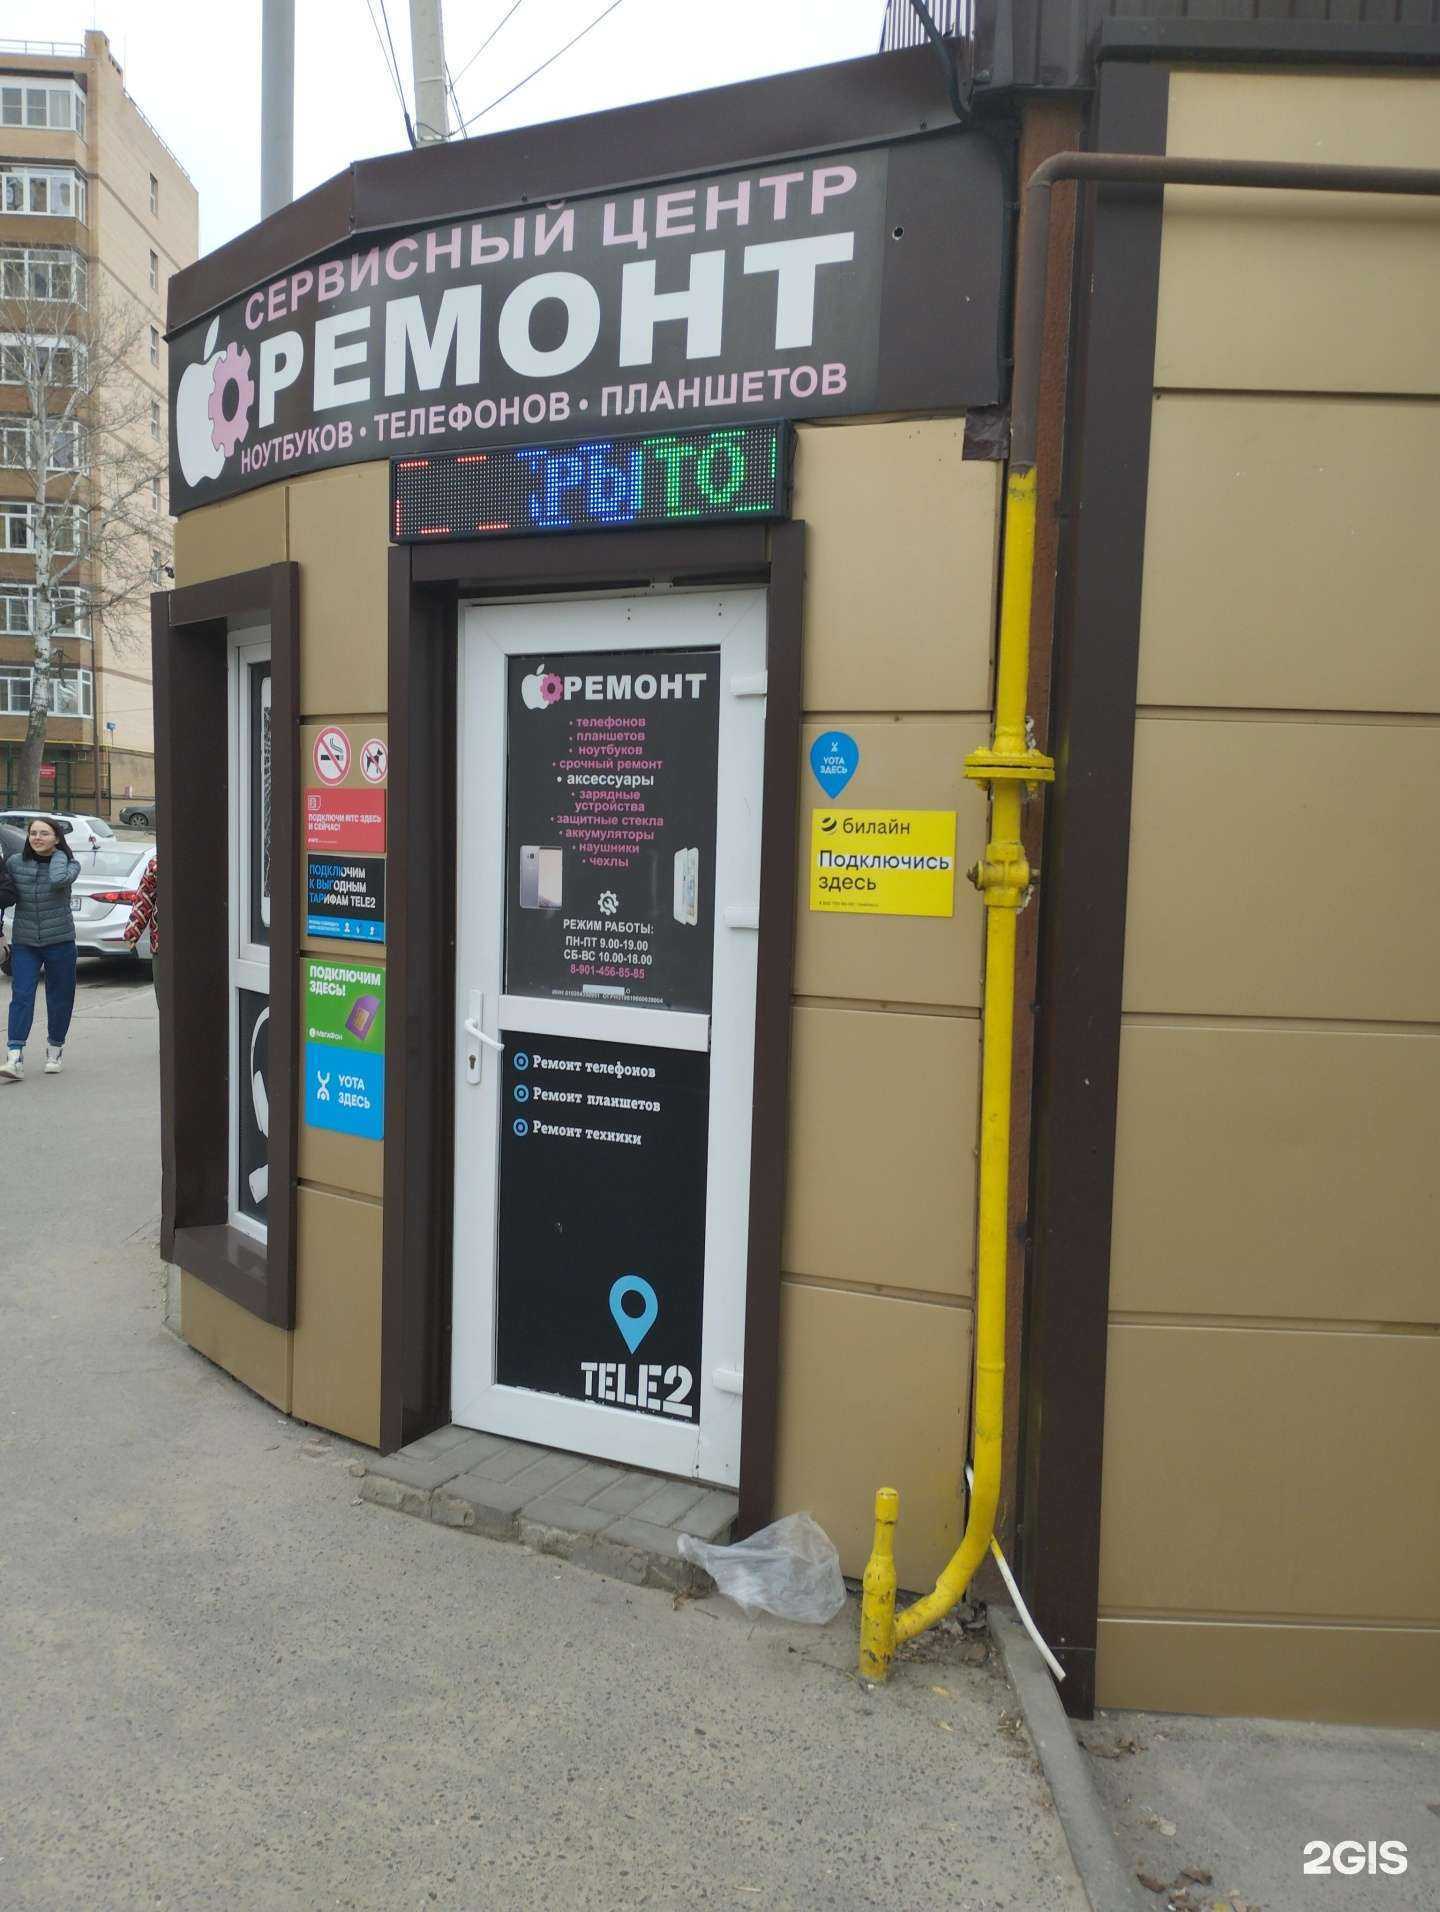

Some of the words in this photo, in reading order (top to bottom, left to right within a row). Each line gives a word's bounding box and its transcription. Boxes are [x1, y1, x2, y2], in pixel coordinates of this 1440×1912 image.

[245, 202, 575, 330] СЕРВИСНЫЙ
[602, 165, 858, 248] ЦЕНТР
[257, 232, 854, 428] РЕМОНТ
[241, 422, 353, 474] НОУТБУКОВ
[374, 391, 570, 441] ТЕЛЕФОНОВ
[601, 363, 847, 417] ПЛАНШЕТОВ
[564, 673, 707, 700] РЕМОНТ
[576, 716, 646, 730] телефонов
[577, 731, 645, 741] планшетов
[579, 744, 643, 757] ноутбуков
[559, 758, 614, 771] срочный
[617, 760, 663, 771] ремонт
[823, 757, 845, 765] YOTA
[820, 765, 848, 775] ЗДЕСЬ
[567, 774, 654, 788] аксессуары
[579, 790, 641, 801] зарядные
[575, 801, 645, 813] устройства
[556, 814, 618, 826] защитные
[622, 816, 664, 826] стекла
[843, 817, 911, 835] билайн
[566, 829, 654, 842] аккумуляторы
[579, 844, 640, 854] наушники
[589, 857, 629, 868] чехлы
[819, 850, 950, 870] Подключись
[309, 864, 365, 879] ПОДКЛЮЧИМ
[309, 879, 315, 889] К
[317, 880, 367, 894] ВЫГОДНЫМ
[818, 876, 877, 892] здесь
[309, 892, 349, 906] ТАРИФАМ
[350, 895, 376, 908] TELE2
[564, 919, 601, 931] РЕЖИМ
[604, 921, 654, 934] РАБОТЫ:
[566, 936, 597, 948] ПН-ПТ
[600, 938, 648, 951] 9.00-19.00
[564, 949, 596, 961] СБ-ВС
[599, 952, 652, 965] 10.00-18.00
[310, 965, 381, 986] ПОДКЛЮЧИМ
[309, 981, 346, 997] ЗДЕСЬ!
[533, 1054, 582, 1072] Ремонт
[586, 1062, 656, 1078] телефонов
[339, 1074, 365, 1091] YOTA
[339, 1092, 371, 1109] ЗДЕСЬ
[533, 1087, 582, 1104] Ремонт
[587, 1094, 661, 1112] планшетов
[533, 1120, 582, 1138] Ремонт
[586, 1129, 642, 1145] техники
[581, 1362, 693, 1418] TELE2
